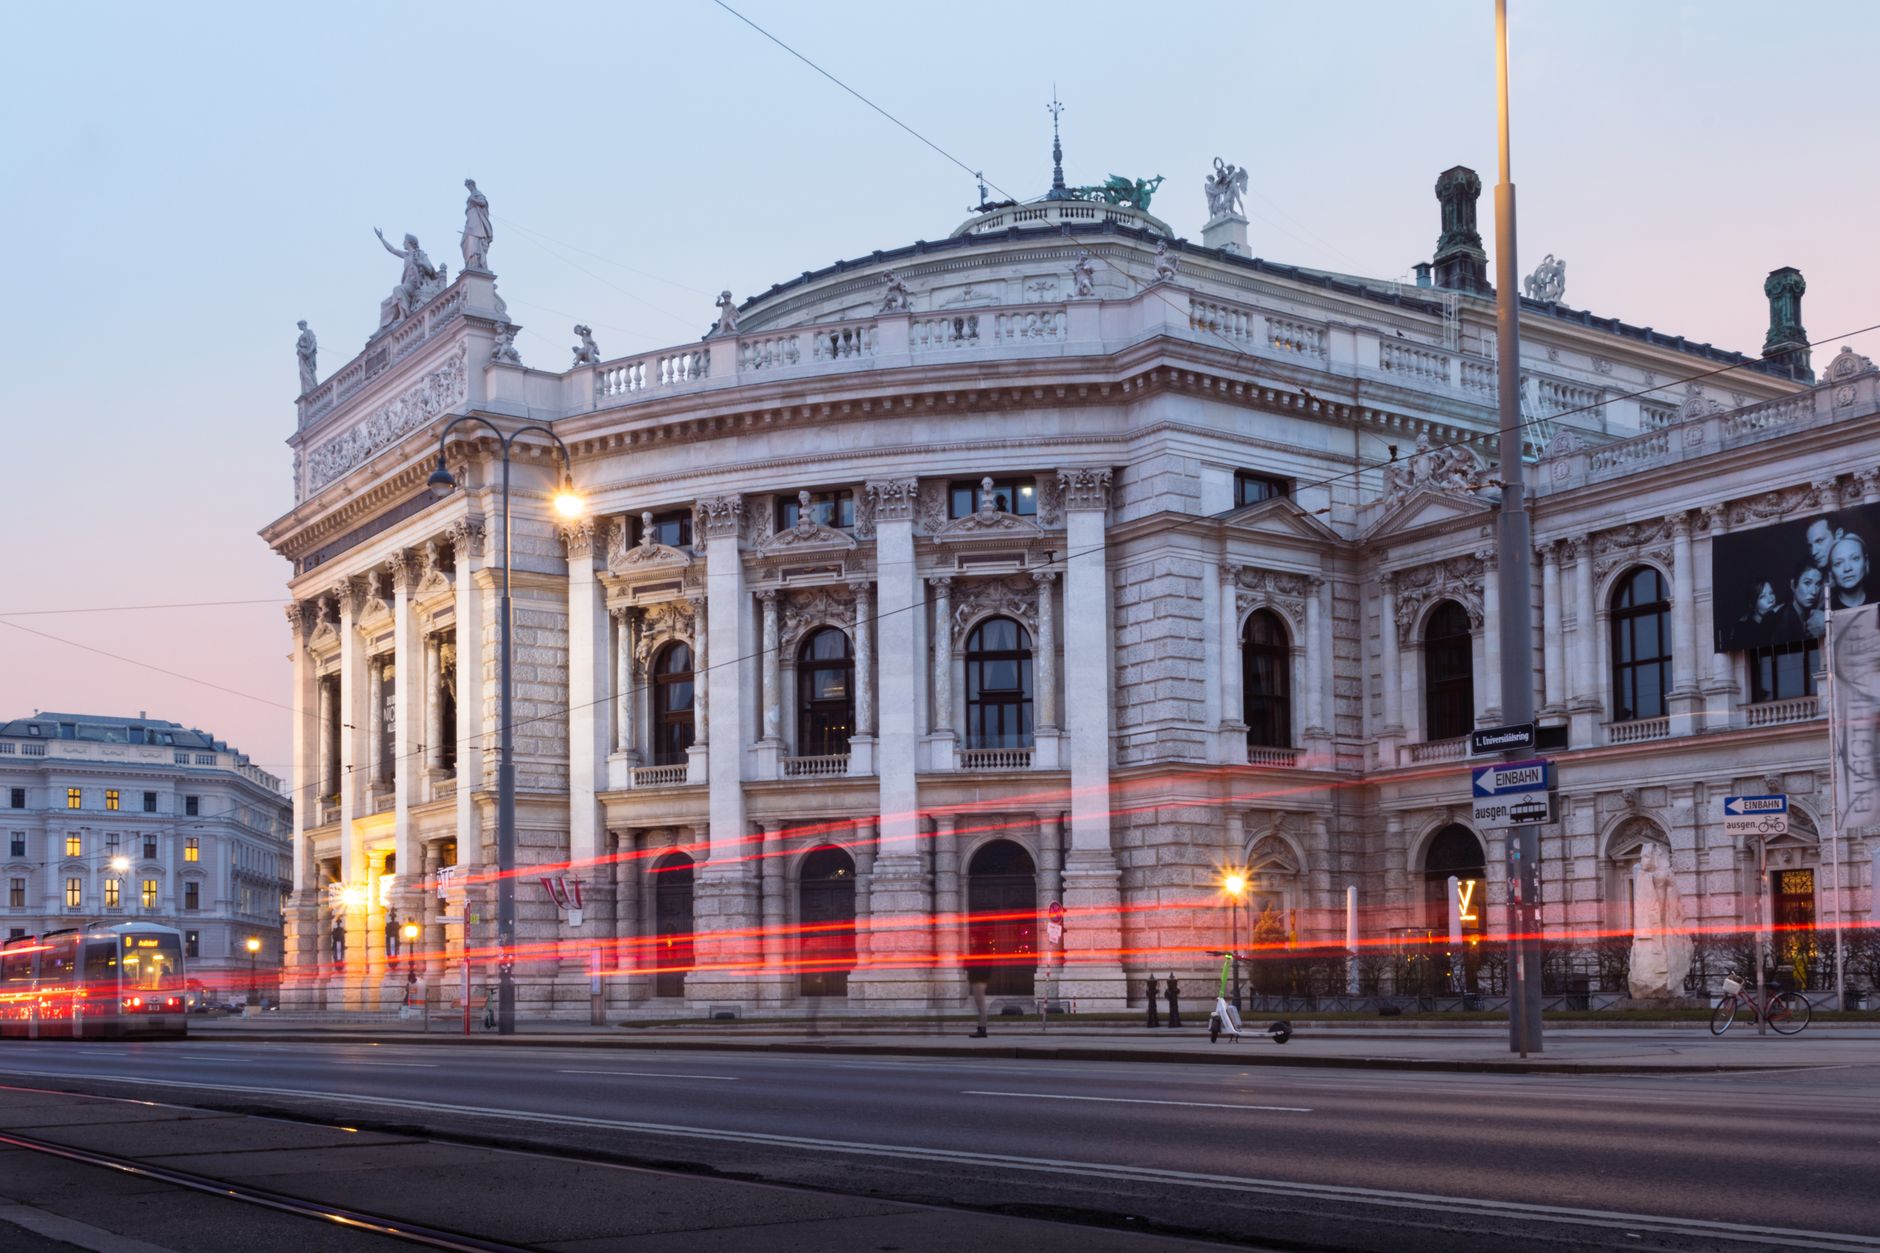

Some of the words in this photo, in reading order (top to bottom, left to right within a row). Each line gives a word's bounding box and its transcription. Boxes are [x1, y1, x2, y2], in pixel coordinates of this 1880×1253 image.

[1475, 737, 1483, 747] 1.
[1482, 731, 1529, 746] Universitätsring
[1495, 768, 1539, 786] EINBAHN
[1474, 805, 1510, 821] ausgen.
[1743, 800, 1780, 810] EINBAHN
[1726, 821, 1758, 831] ausgen.
